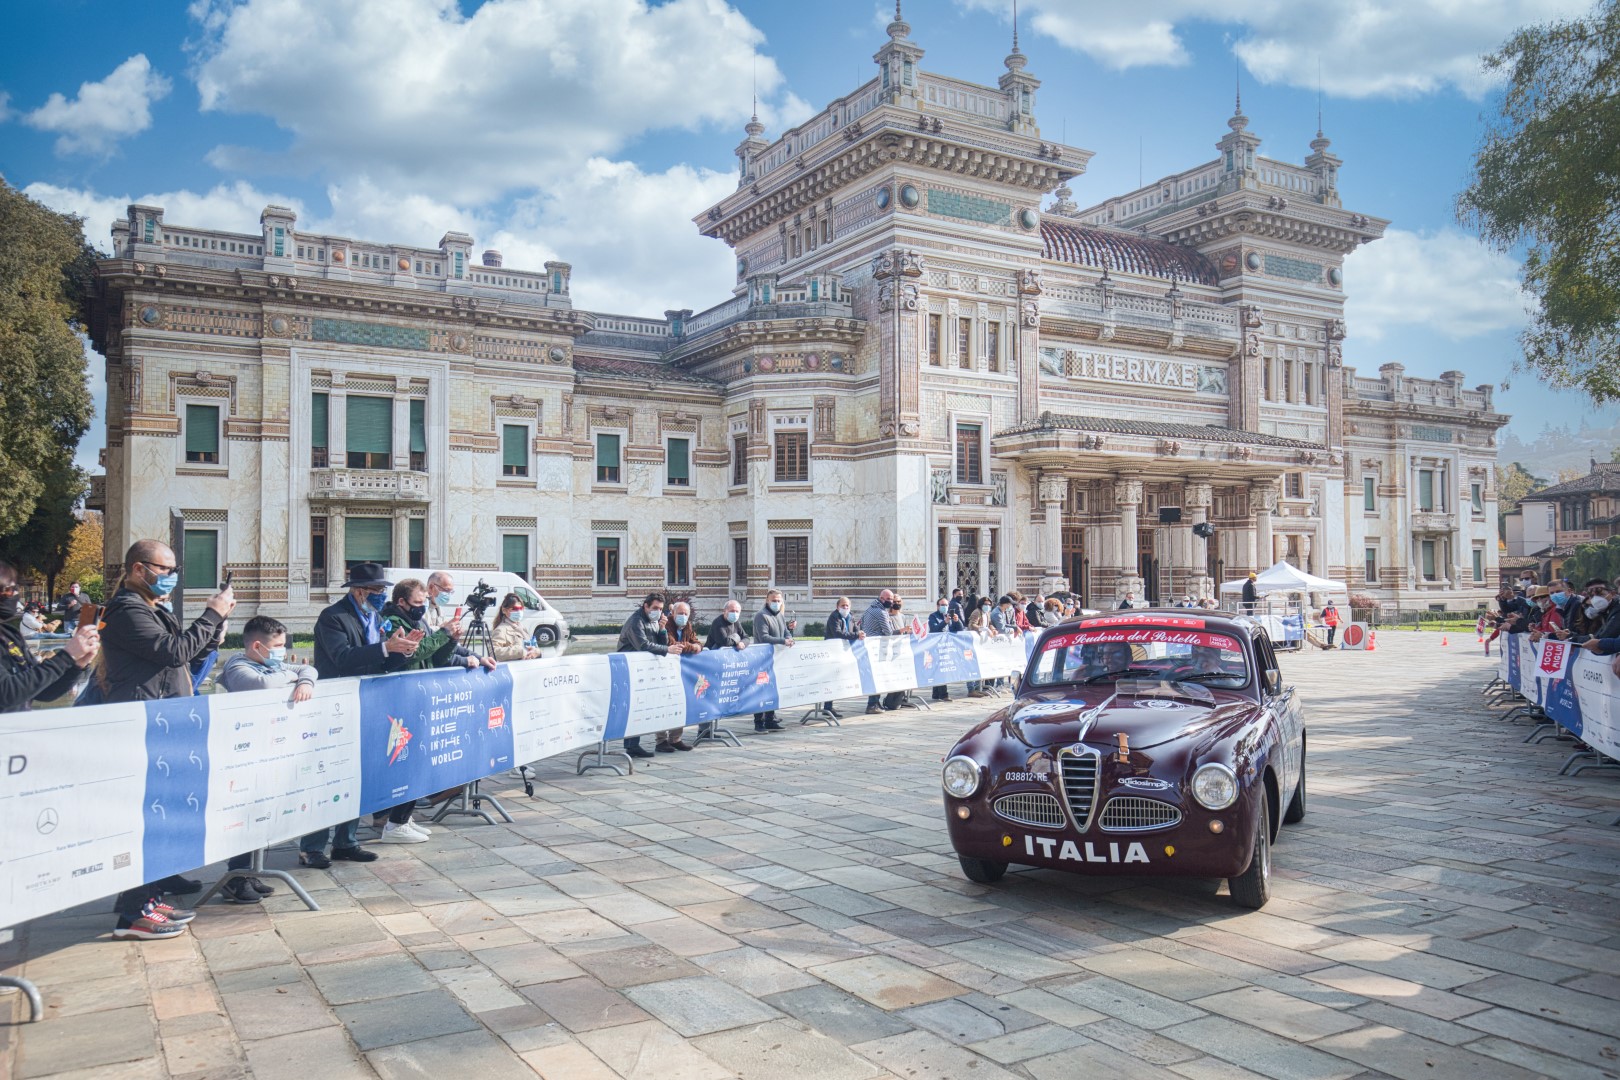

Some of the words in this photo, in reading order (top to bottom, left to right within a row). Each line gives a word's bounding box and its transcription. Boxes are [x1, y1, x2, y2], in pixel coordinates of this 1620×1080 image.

[1075, 352, 1195, 386] THERMAE
[1072, 632, 1125, 645] Scuderia
[1127, 630, 1150, 641] del
[1151, 630, 1202, 644] Portello
[800, 652, 830, 661] CHOPARD
[1543, 645, 1554, 666] 1000
[1552, 644, 1564, 668] MIGLIA
[543, 674, 580, 688] CHOPARD
[431, 694, 452, 706] THE
[454, 690, 473, 702] MOST
[431, 703, 475, 721] BEAUTIFUL
[1023, 703, 1071, 712] 500
[431, 721, 457, 736] RACE
[440, 735, 460, 749] THE
[431, 749, 463, 766] WORLD
[1118, 777, 1174, 788] Guidosimplex
[1024, 834, 1151, 864] ITALIA
